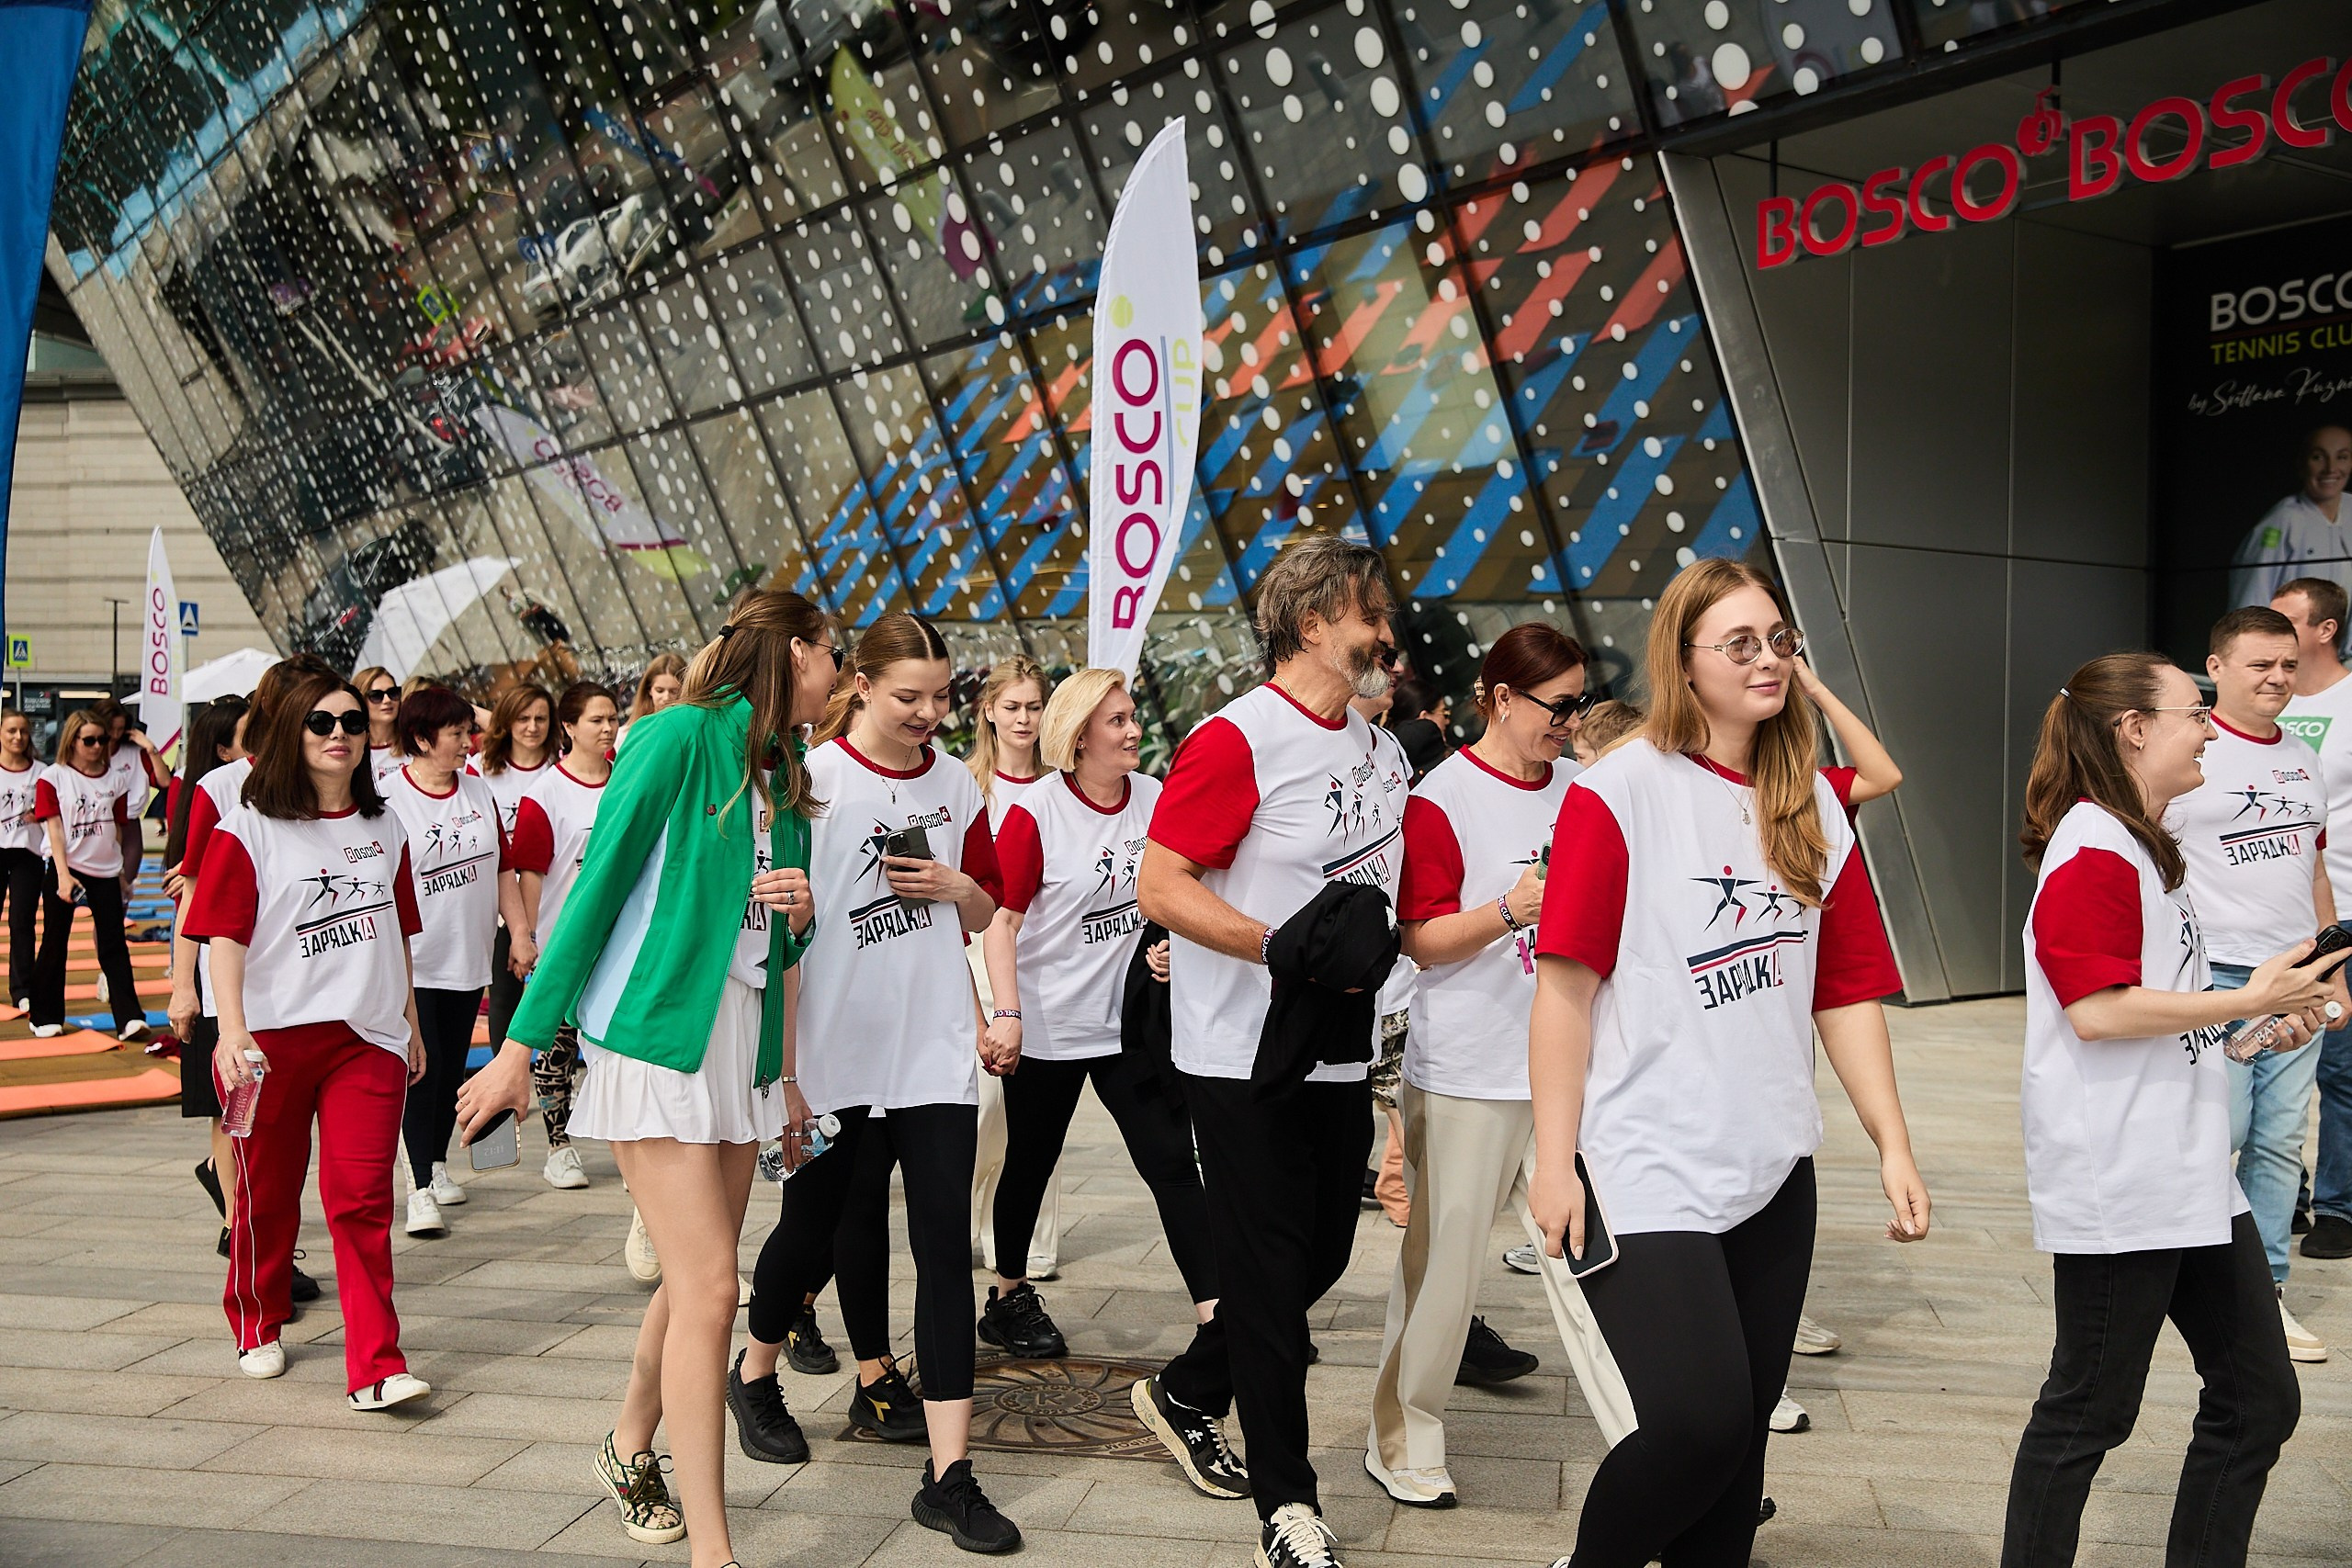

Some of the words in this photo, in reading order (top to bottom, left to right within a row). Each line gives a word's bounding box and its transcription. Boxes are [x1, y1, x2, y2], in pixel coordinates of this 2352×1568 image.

[1757, 142, 2022, 270] BOSCO
[2069, 55, 2352, 201] BOSC
[2210, 332, 2301, 365] TENNIS
[2188, 393, 2207, 415] by
[1112, 338, 1163, 629] BOSCO
[150, 587, 168, 696] BOSCO
[2278, 721, 2325, 738] SCO
[2223, 833, 2301, 866] ЗАРЯДКА
[424, 864, 478, 897] ЗАРЯДКА
[300, 916, 377, 958] ЗАРЯДКА
[853, 904, 933, 951] ЗАРЯДКА
